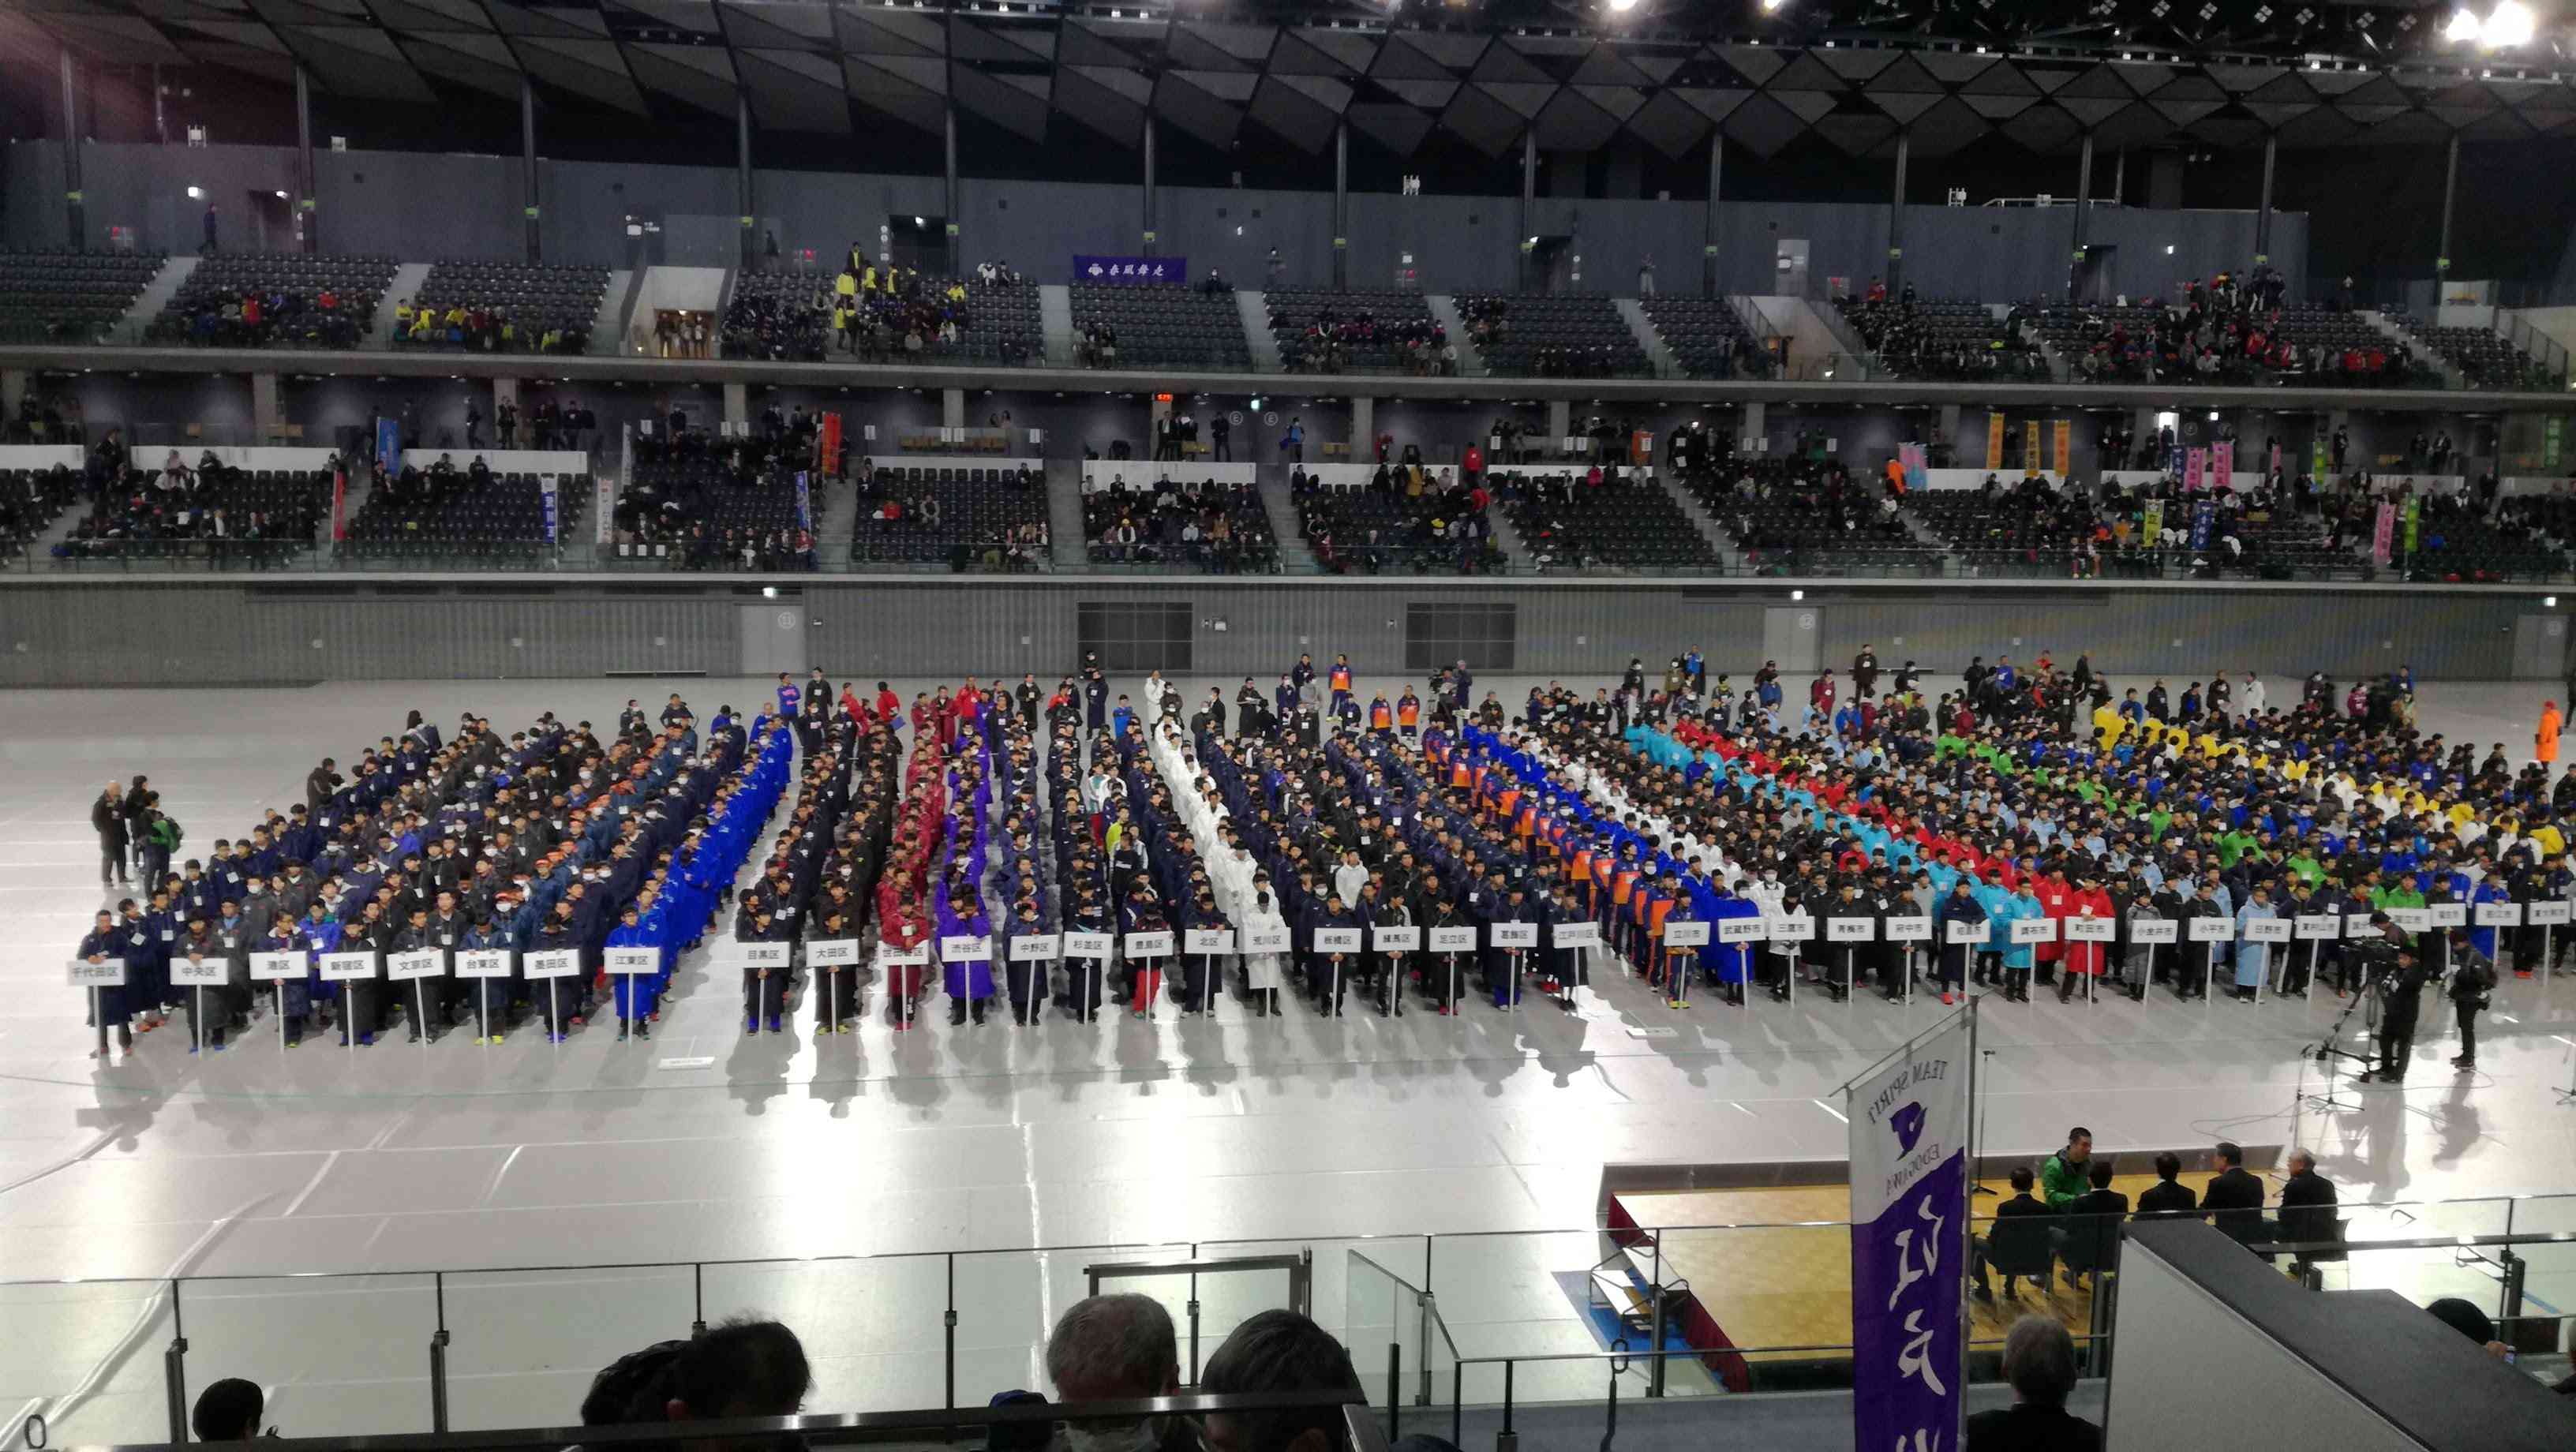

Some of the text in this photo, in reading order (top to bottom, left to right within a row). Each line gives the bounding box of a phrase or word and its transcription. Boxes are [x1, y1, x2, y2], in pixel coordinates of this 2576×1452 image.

[1724, 923, 1761, 935] 武蔵野市
[1199, 937, 1219, 947] 北区
[1439, 934, 1468, 945] 足立区
[1020, 942, 1049, 953] 中野区
[1073, 940, 1103, 951] 杉並区
[747, 949, 780, 960] 目黒区
[815, 947, 848, 959] 大田区
[398, 957, 433, 972] 文京区
[615, 955, 649, 966] 江東区
[72, 967, 117, 977] 千代田区
[181, 965, 217, 977] 中央区
